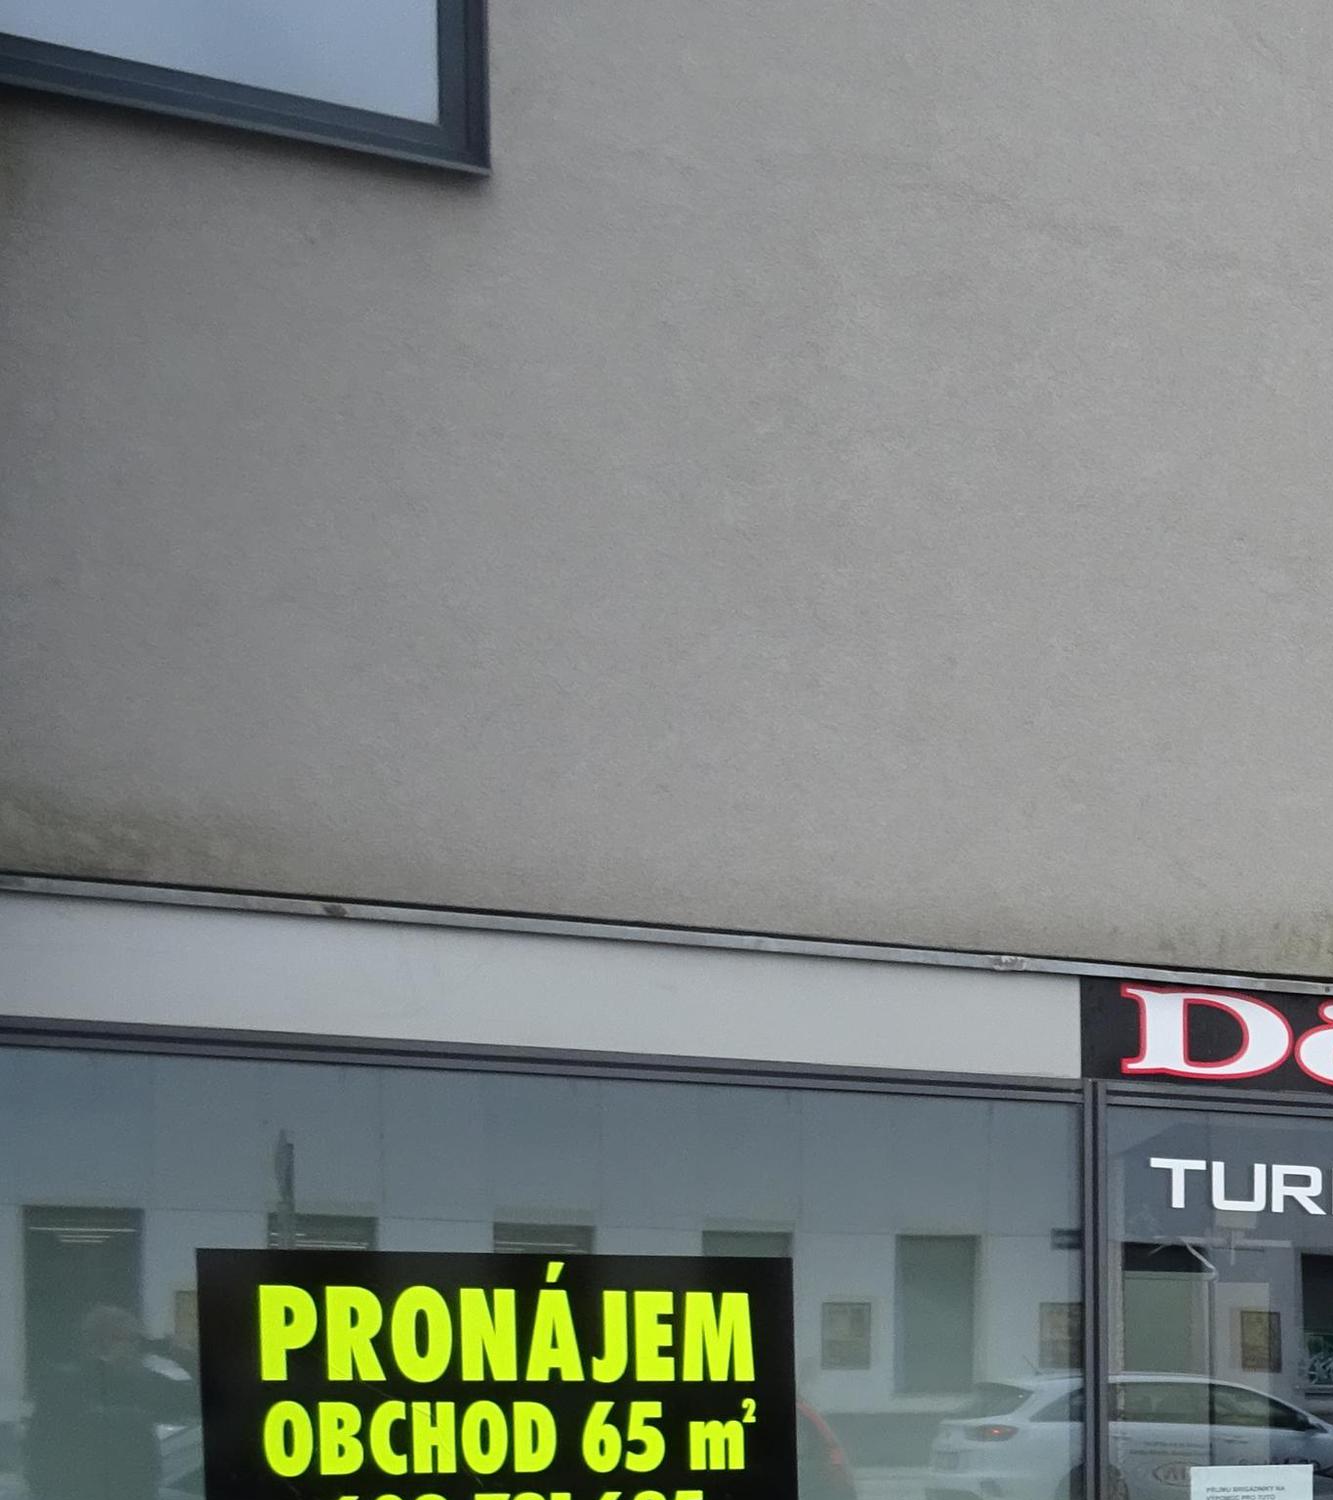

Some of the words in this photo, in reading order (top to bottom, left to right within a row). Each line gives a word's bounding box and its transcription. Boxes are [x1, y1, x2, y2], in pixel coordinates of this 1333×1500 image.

[258, 1261, 755, 1383] PRONÁJEM
[263, 1400, 557, 1477] OBCHOD
[582, 1401, 666, 1473] 65
